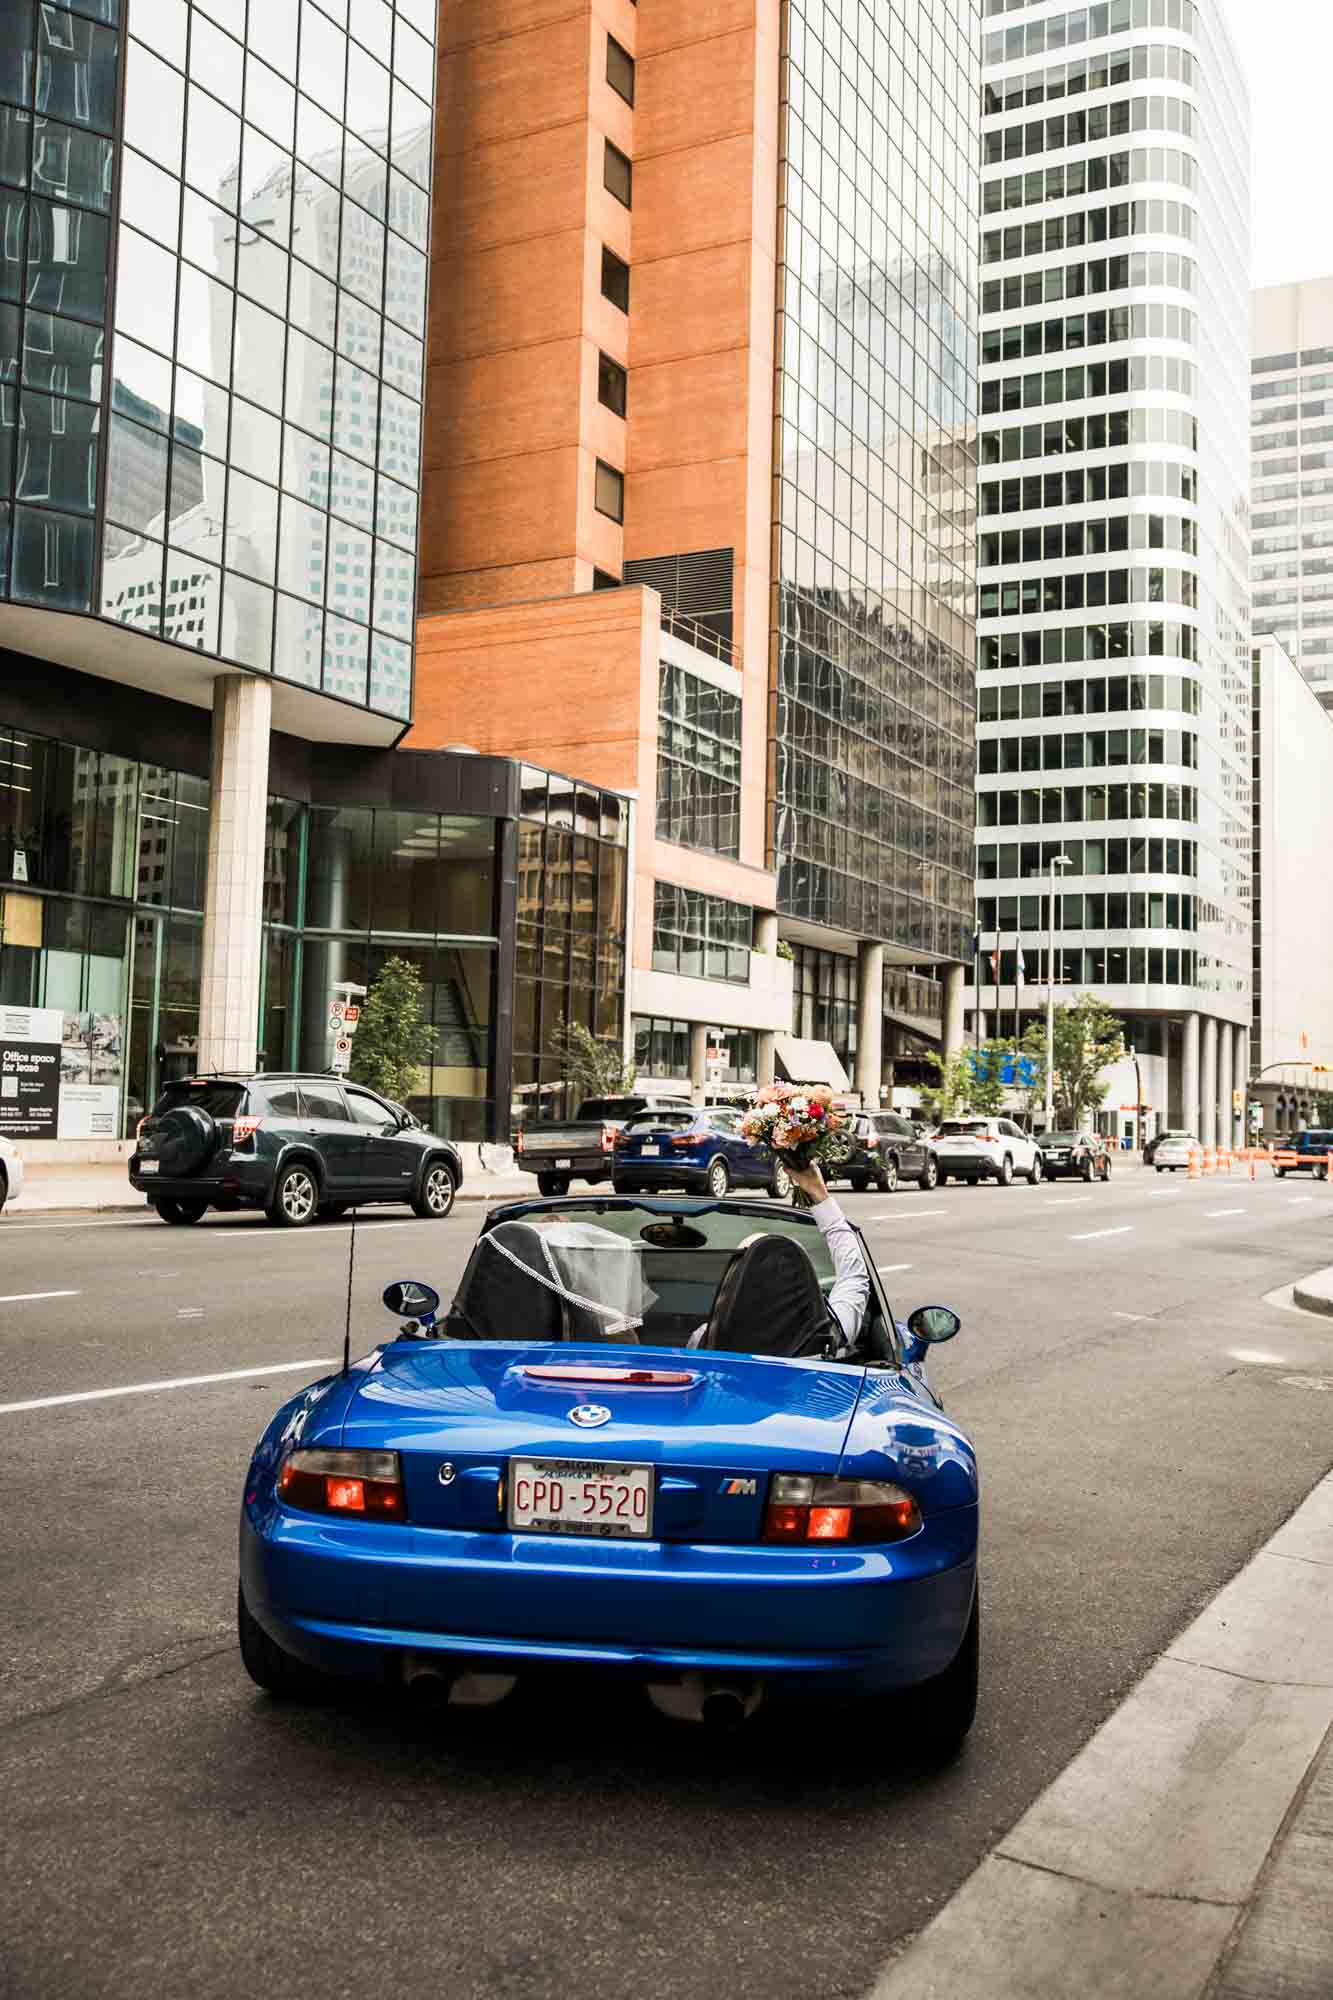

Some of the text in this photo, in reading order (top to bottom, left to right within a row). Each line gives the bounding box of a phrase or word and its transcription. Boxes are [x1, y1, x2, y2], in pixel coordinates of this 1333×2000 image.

[2, 1050, 55, 1065] Office space
[2, 1061, 39, 1072] for lease
[516, 1479, 646, 1517] CPD-5520
